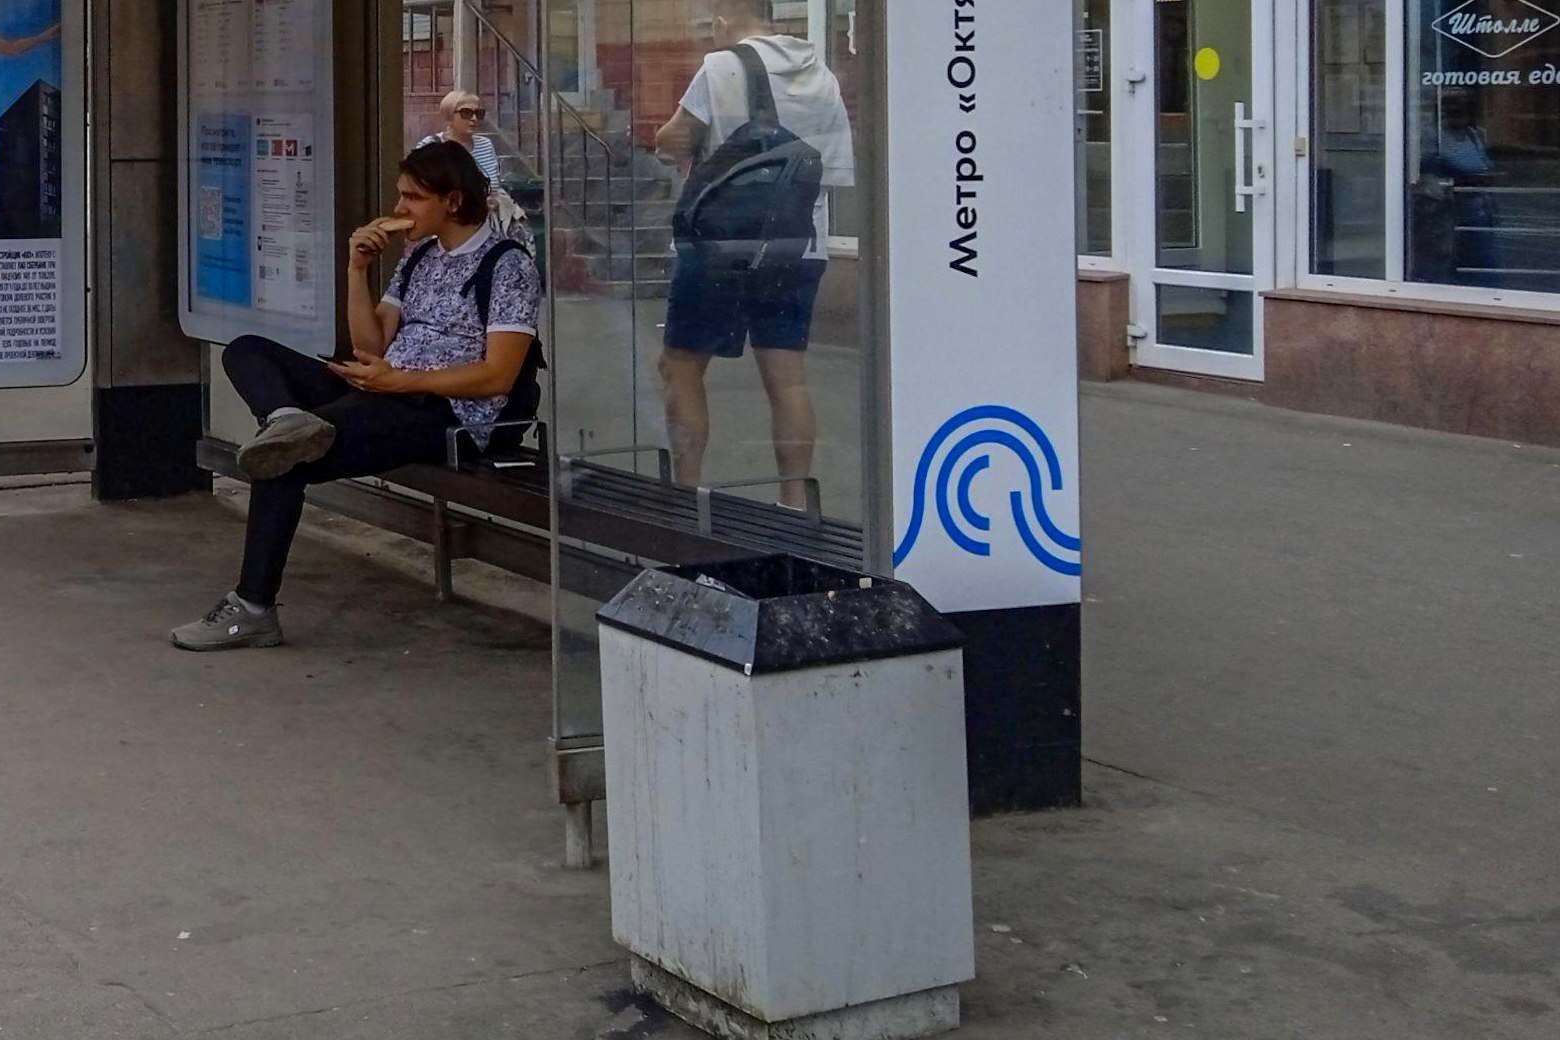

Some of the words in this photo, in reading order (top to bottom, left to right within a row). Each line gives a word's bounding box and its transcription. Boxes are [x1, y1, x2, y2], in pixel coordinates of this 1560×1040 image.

[1448, 12, 1540, 35] Штолле
[1421, 70, 1521, 86] готовая
[1528, 63, 1560, 86] ед
[949, 131, 984, 278] Метро
